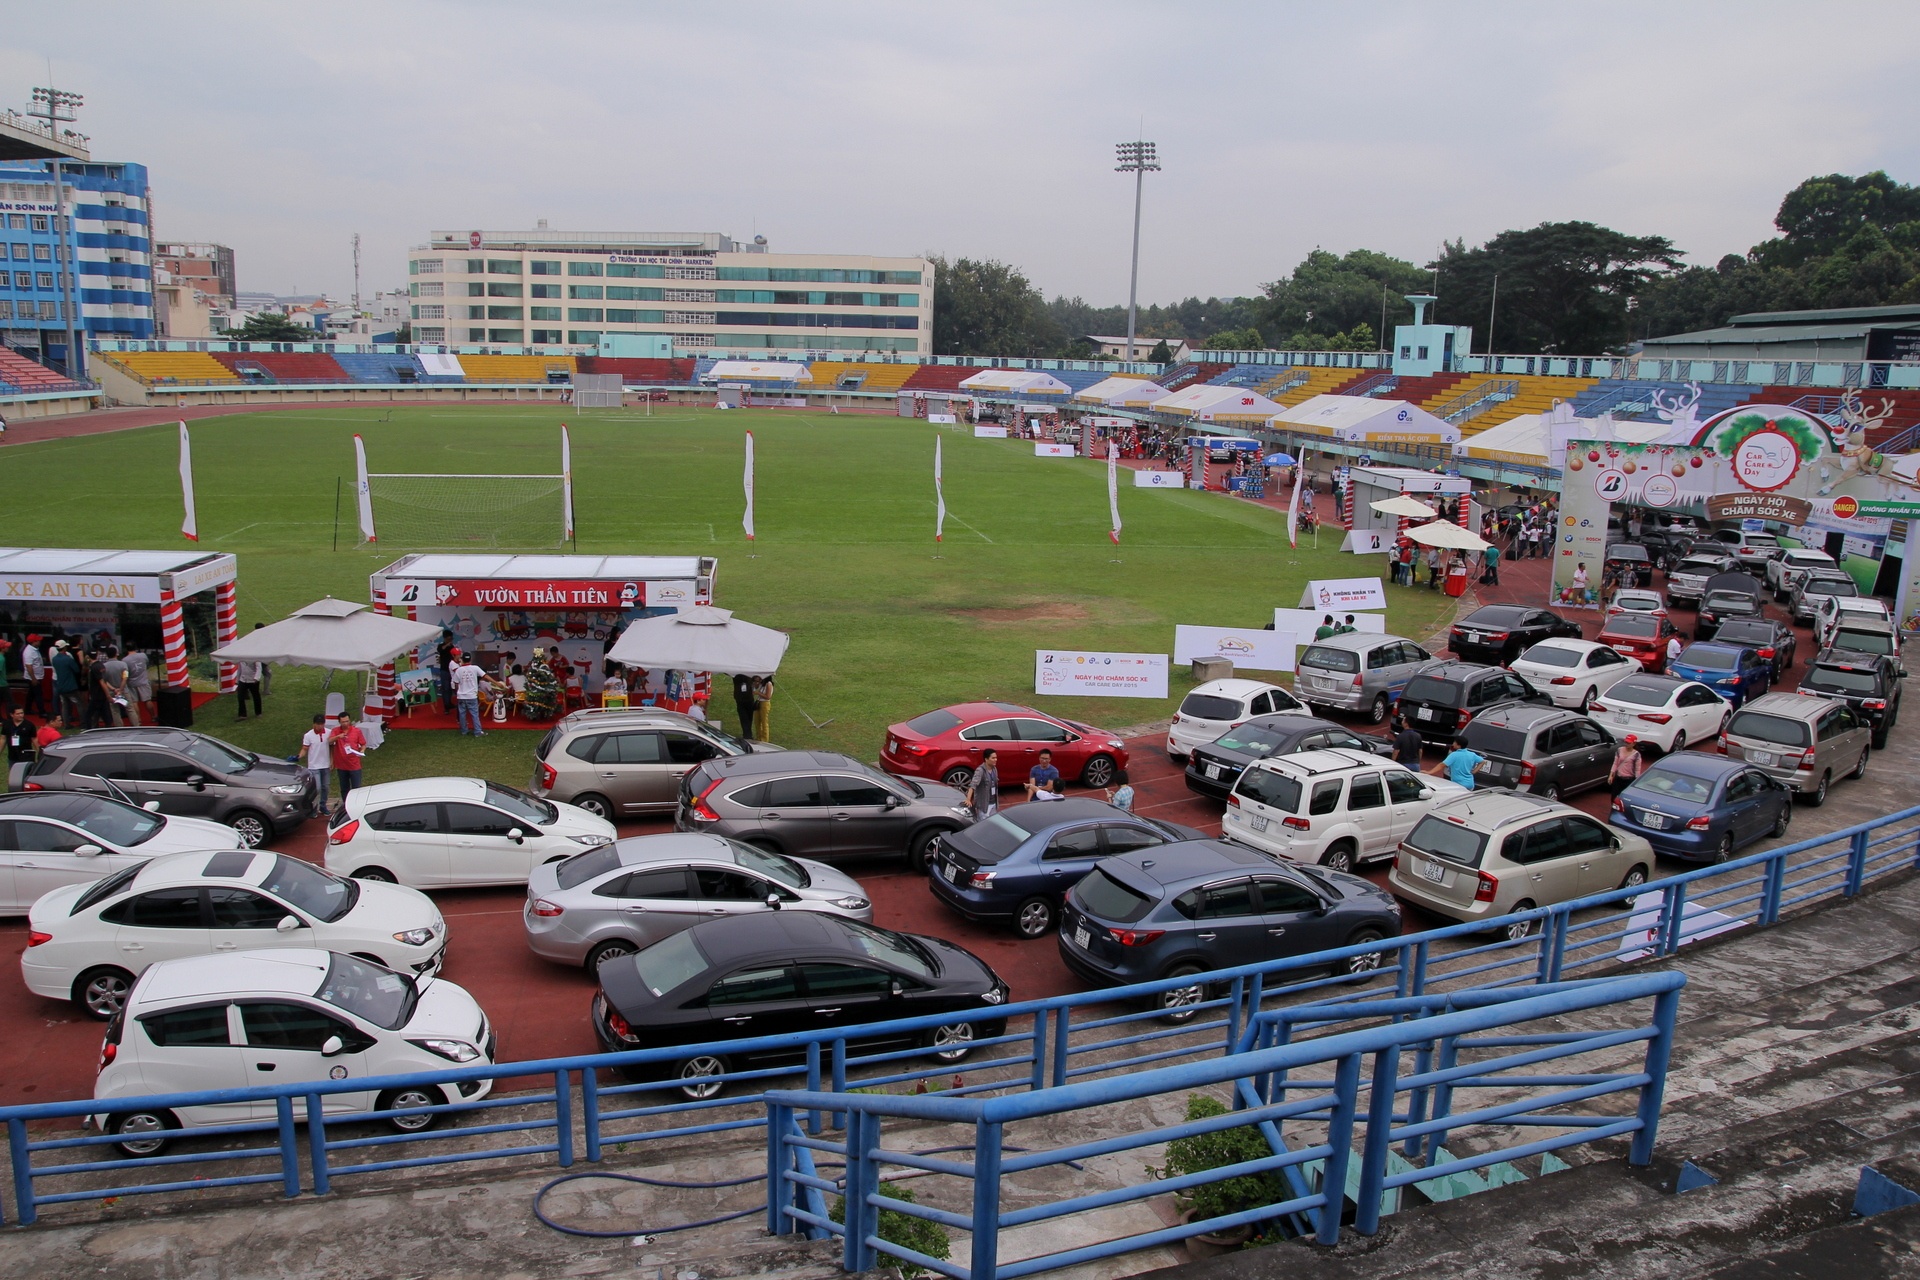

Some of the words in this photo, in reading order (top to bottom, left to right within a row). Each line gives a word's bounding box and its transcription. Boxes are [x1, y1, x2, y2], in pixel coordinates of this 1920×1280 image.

[1734, 495, 1765, 505] NGÀY
[1767, 497, 1787, 507] HỘI
[1833, 503, 1856, 512] DANGER
[1721, 505, 1754, 516] CHĂM
[1757, 506, 1780, 516] SÓC
[1781, 510, 1797, 520] XE
[6, 582, 34, 597] XE
[40, 582, 70, 597] AN
[77, 578, 135, 598] TOÀN
[474, 586, 520, 604] VƯỜN
[524, 583, 567, 604] THẦN
[571, 587, 608, 604] TIÊN
[1429, 863, 1439, 872] 51A
